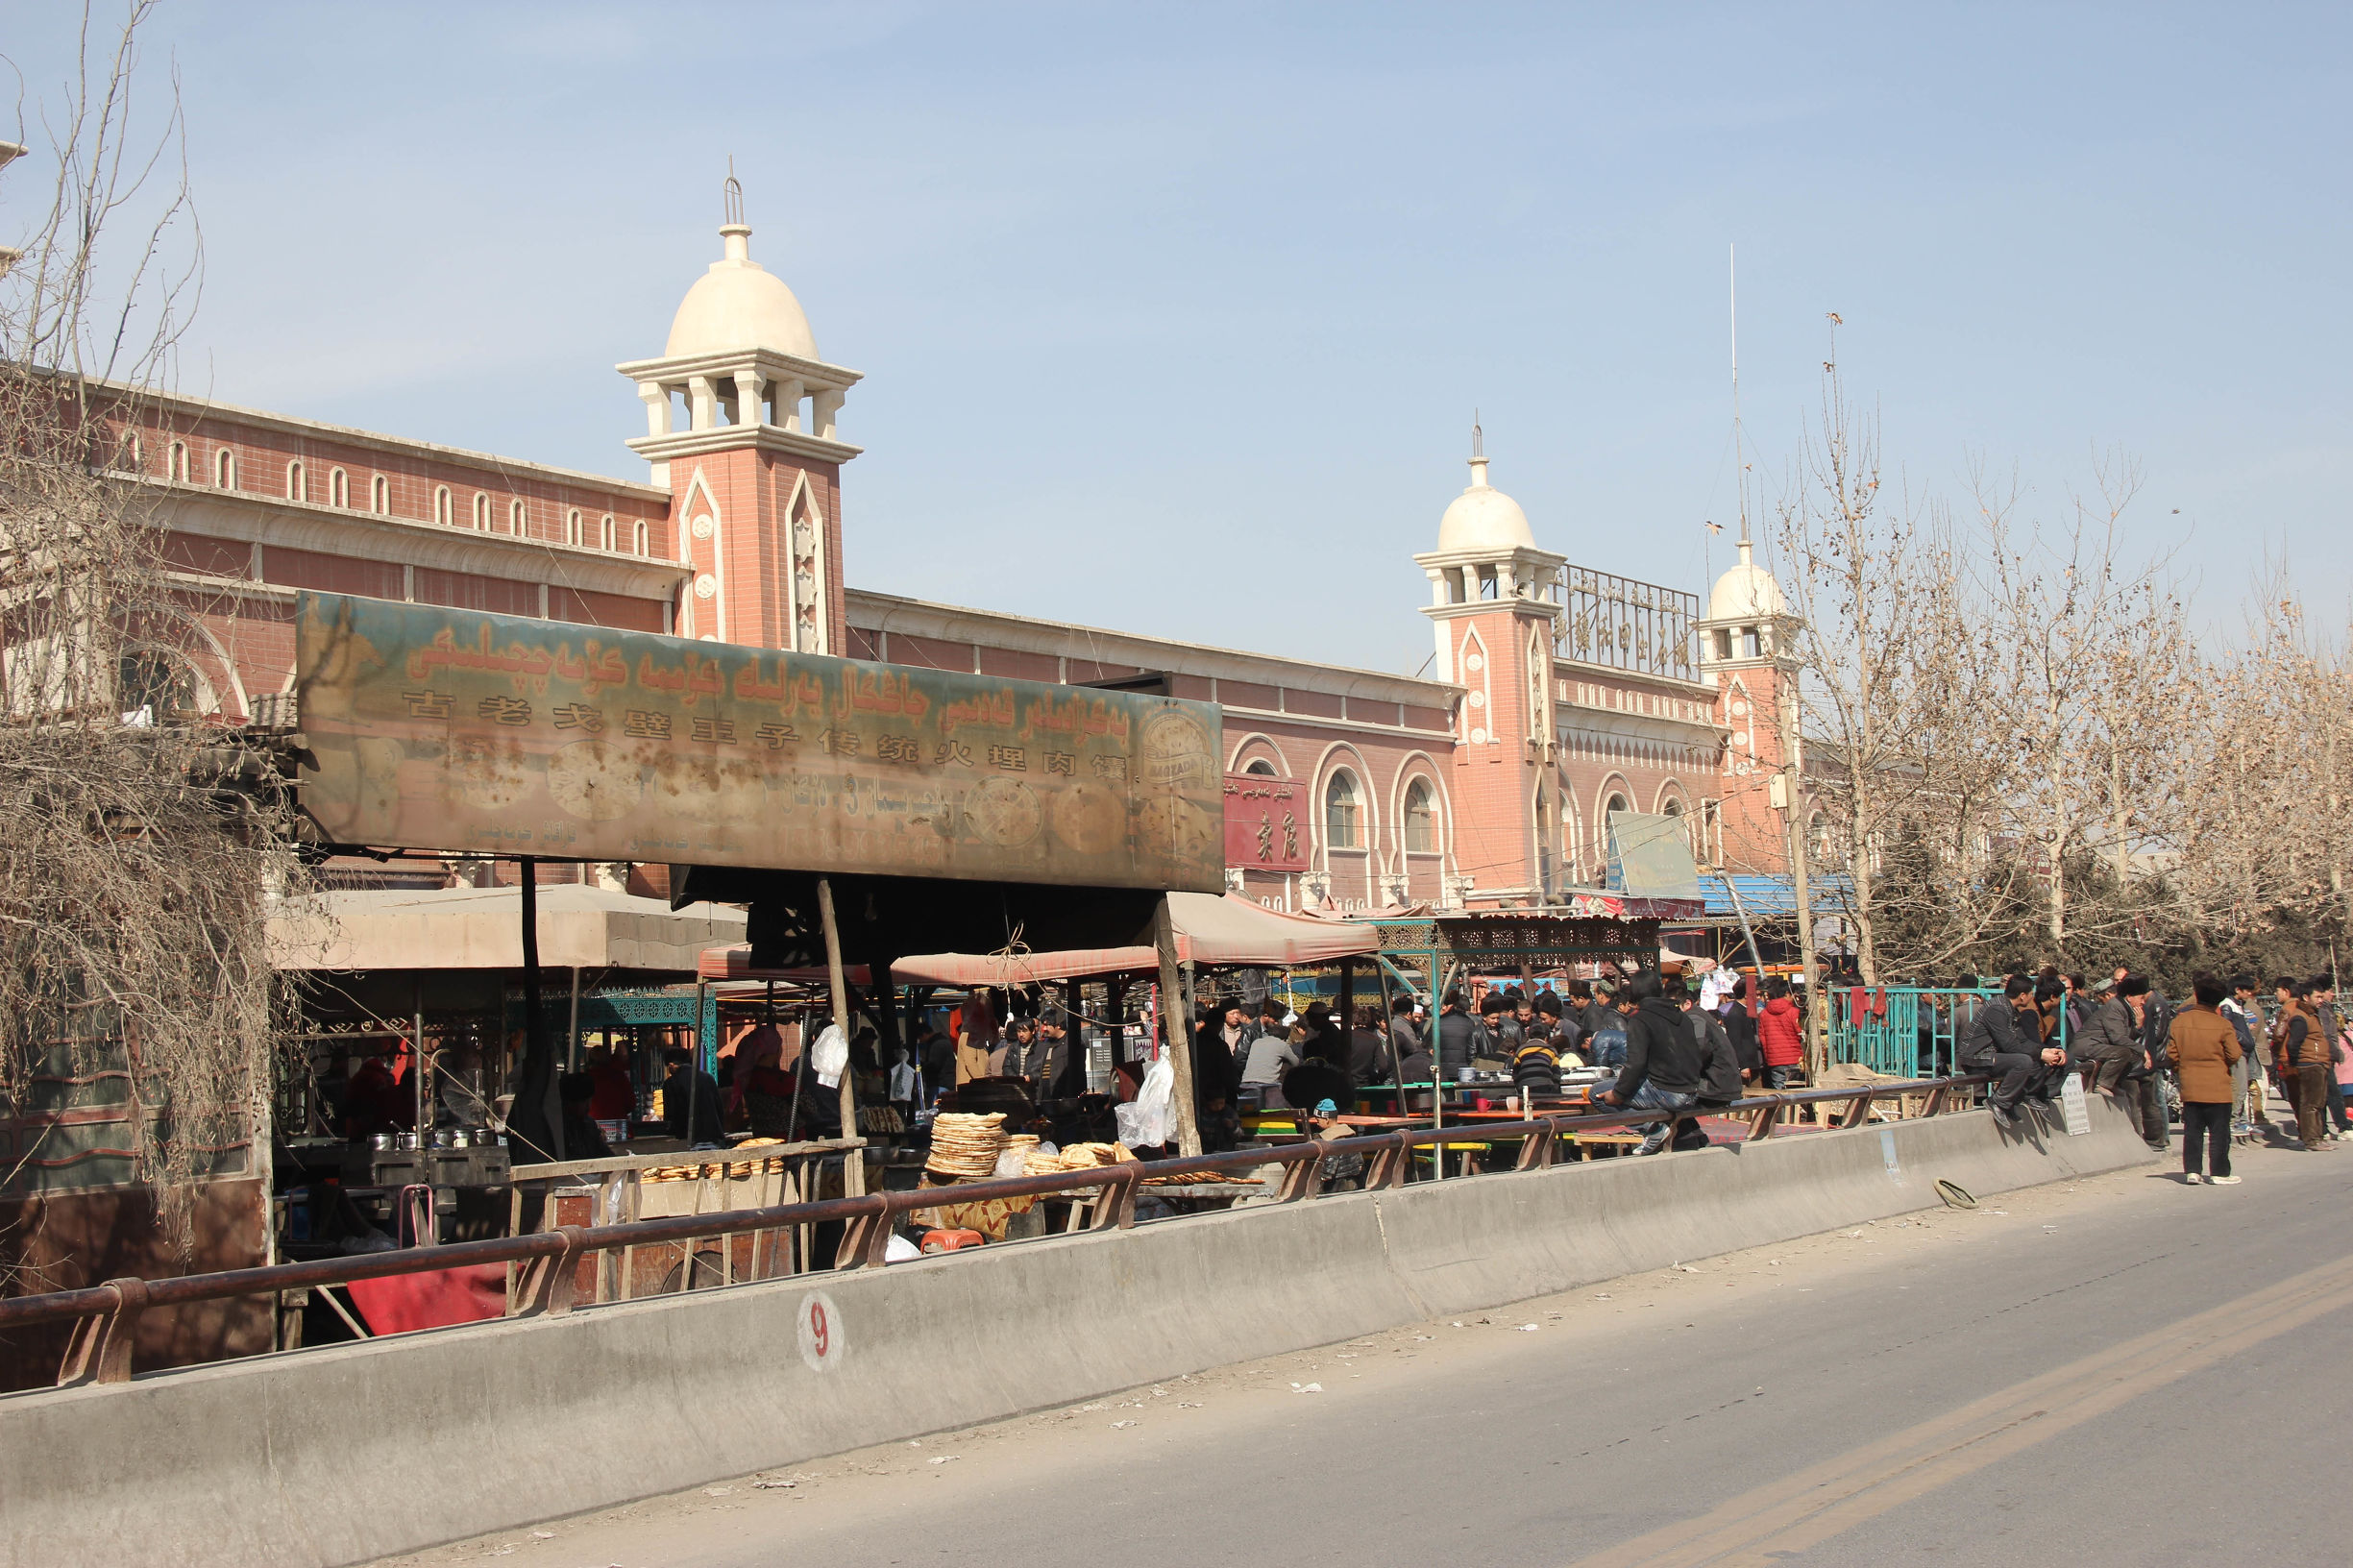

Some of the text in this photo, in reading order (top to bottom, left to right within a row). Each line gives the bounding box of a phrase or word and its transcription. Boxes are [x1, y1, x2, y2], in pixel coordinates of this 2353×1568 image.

[402, 690, 1127, 781] 古老戈壁王子传统火埋肉馕
[811, 1301, 828, 1358] 9
